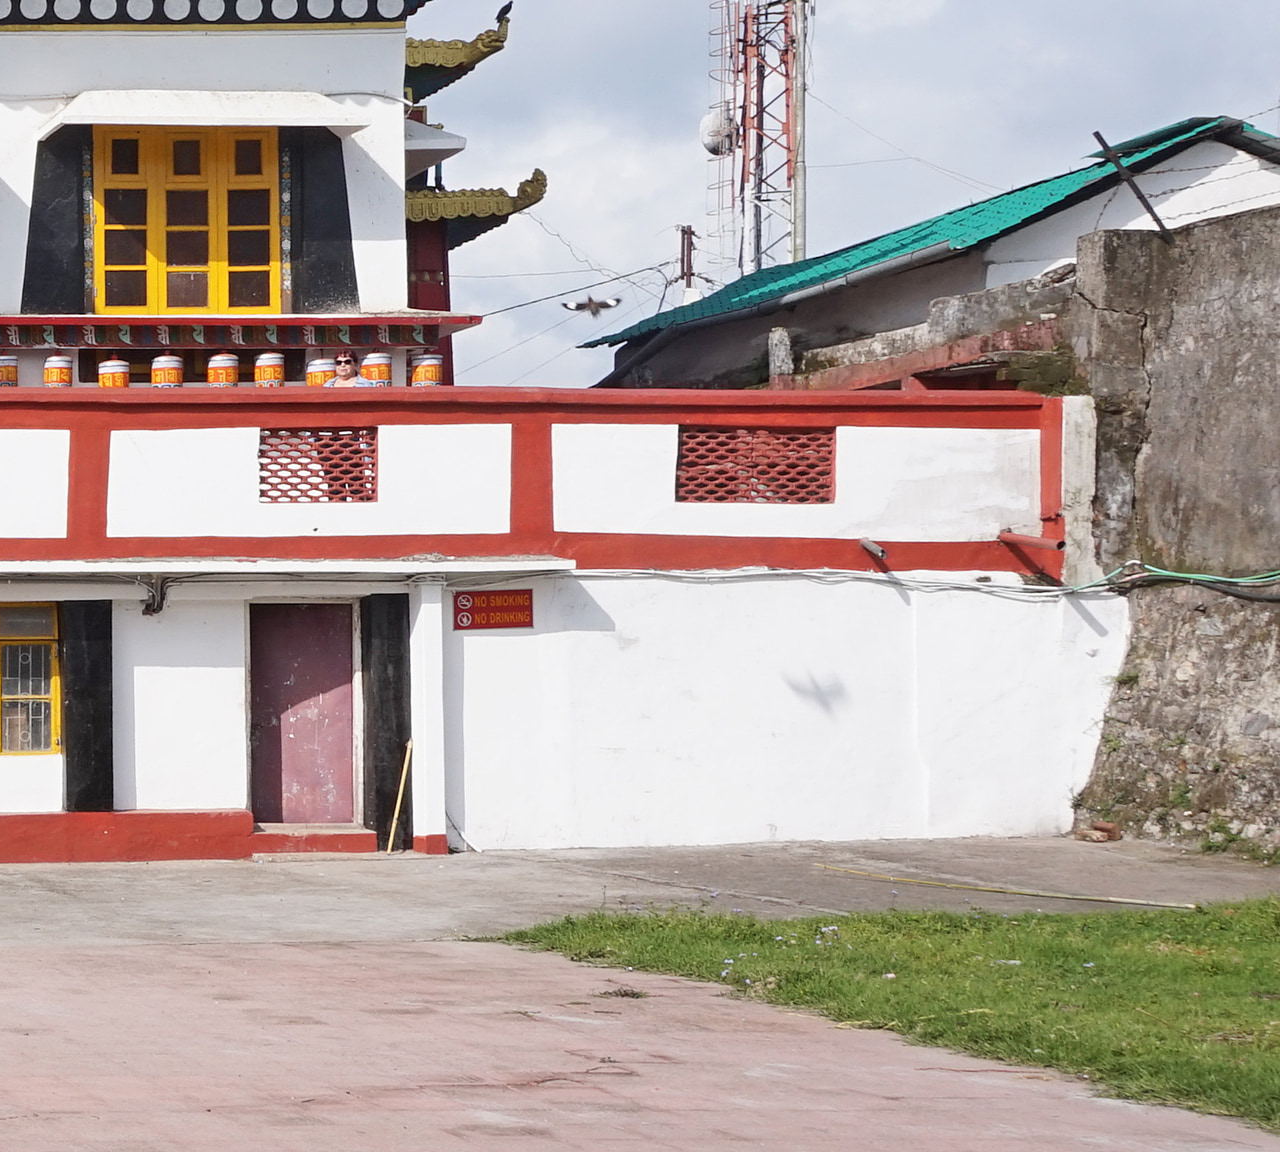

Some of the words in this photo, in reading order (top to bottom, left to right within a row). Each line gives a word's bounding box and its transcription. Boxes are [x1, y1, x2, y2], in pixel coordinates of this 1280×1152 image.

[474, 596, 487, 607] NO
[489, 594, 530, 607] SMOKING
[474, 613, 487, 624] NO
[489, 611, 530, 624] DRINKING
